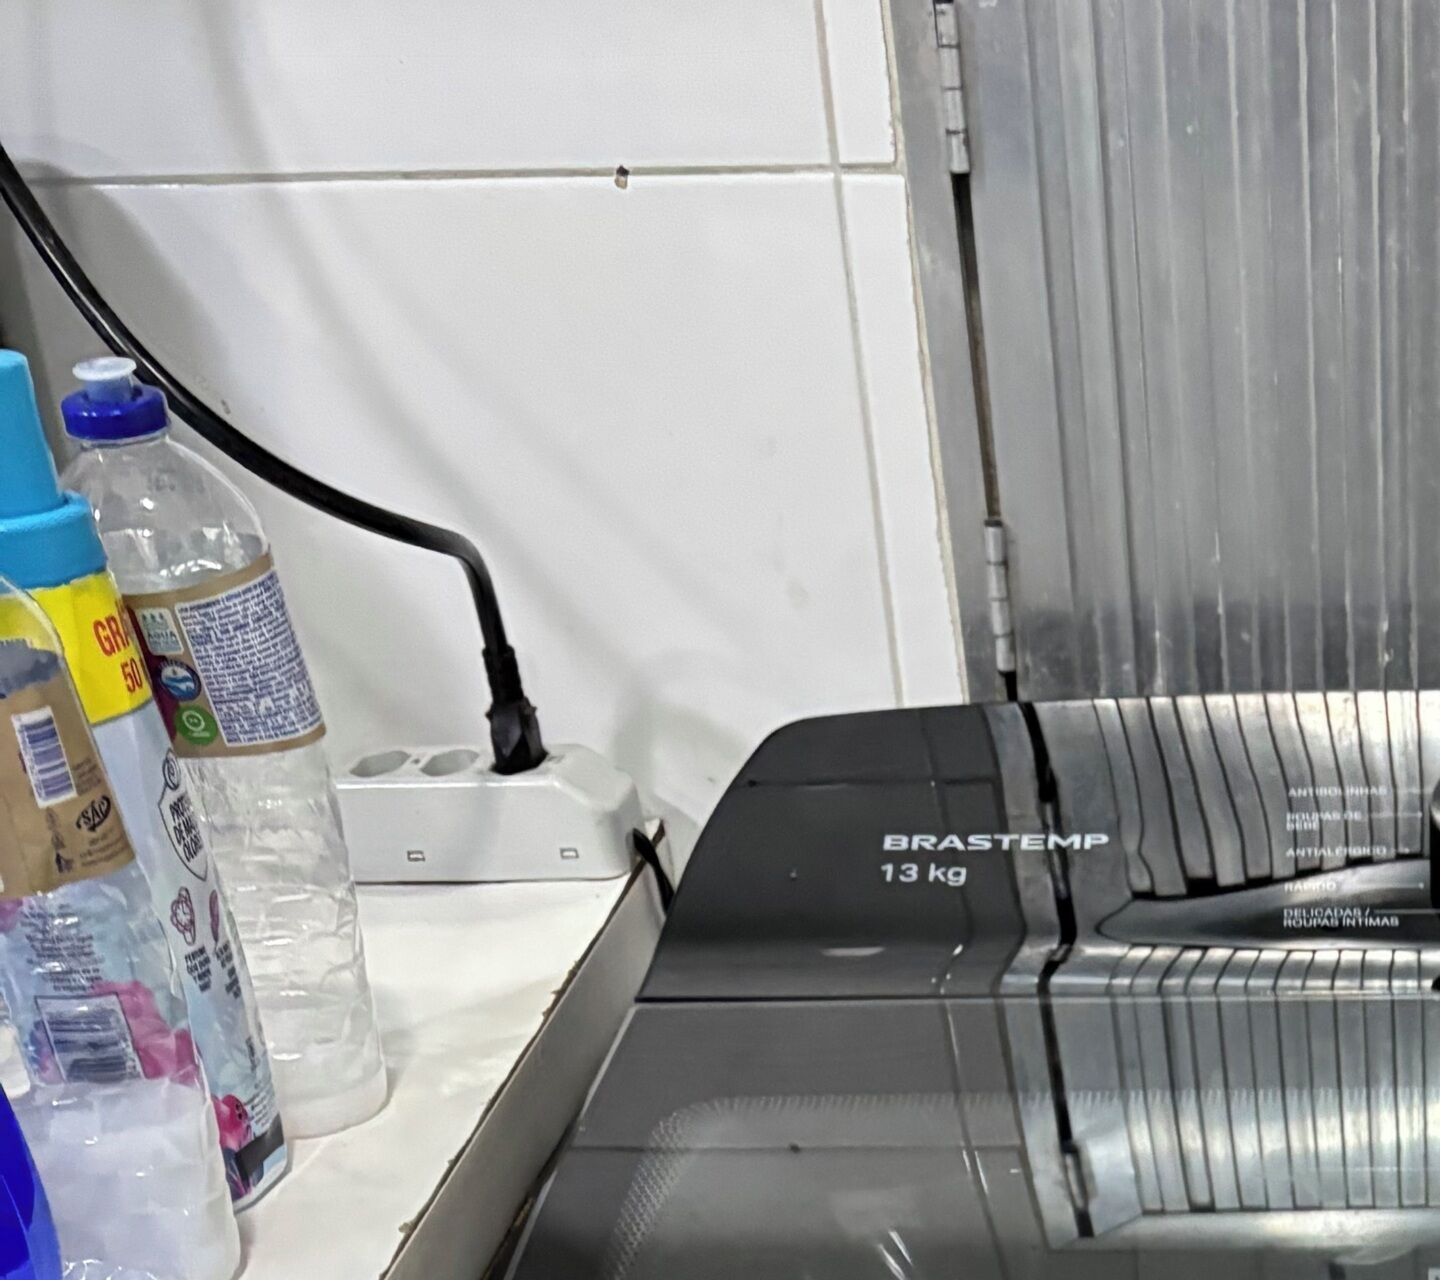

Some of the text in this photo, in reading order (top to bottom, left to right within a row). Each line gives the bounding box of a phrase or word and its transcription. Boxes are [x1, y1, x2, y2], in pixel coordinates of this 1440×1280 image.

[121, 658, 143, 693] 50
[882, 834, 1110, 851] BRASTEMP
[880, 862, 967, 887] 13 kg
[1283, 908, 1362, 918] DELICADAS
[1283, 917, 1339, 928] ROUPAS
